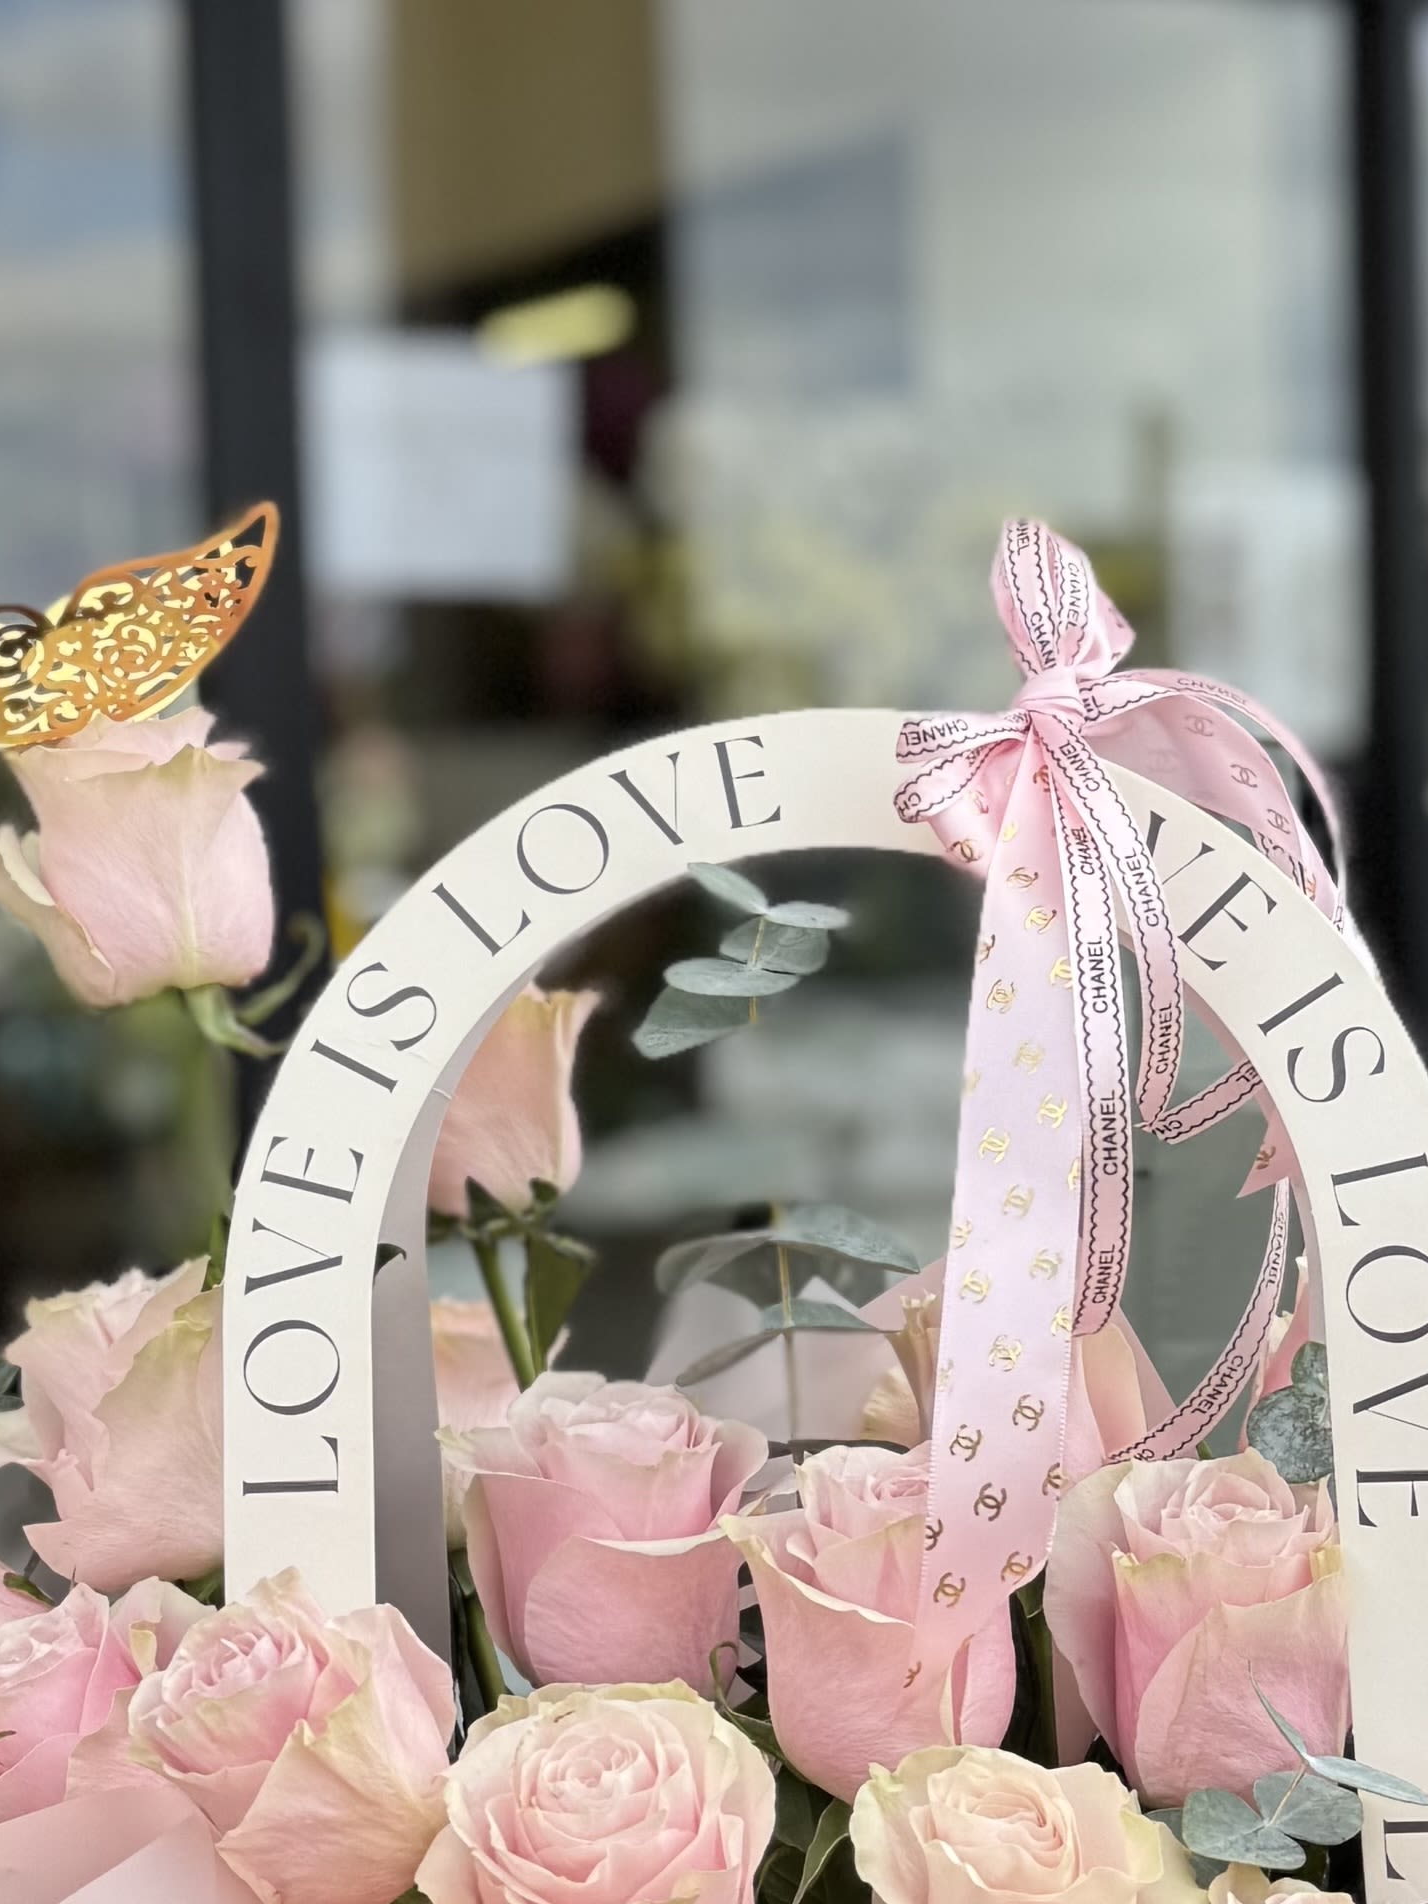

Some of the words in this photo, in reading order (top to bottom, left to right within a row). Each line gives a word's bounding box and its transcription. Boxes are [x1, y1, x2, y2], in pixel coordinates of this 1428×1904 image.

[1066, 562, 1082, 630] CHANEL
[899, 718, 969, 747] CHANEL
[1058, 739, 1101, 793] CHANEL
[1071, 825, 1096, 876] CHANEL
[1122, 845, 1160, 928] CHANEL
[1087, 935, 1108, 1015] CHANEL
[1155, 1002, 1173, 1075] CHANEL
[1257, 971, 1385, 1103] IS
[242, 1135, 365, 1496] LOVE
[310, 961, 438, 1094] IS
[432, 735, 782, 958] LOVE
[1102, 1089, 1119, 1177] CHANEL
[1091, 1244, 1116, 1305] CHANEL
[1191, 1354, 1245, 1417] CHANEL
